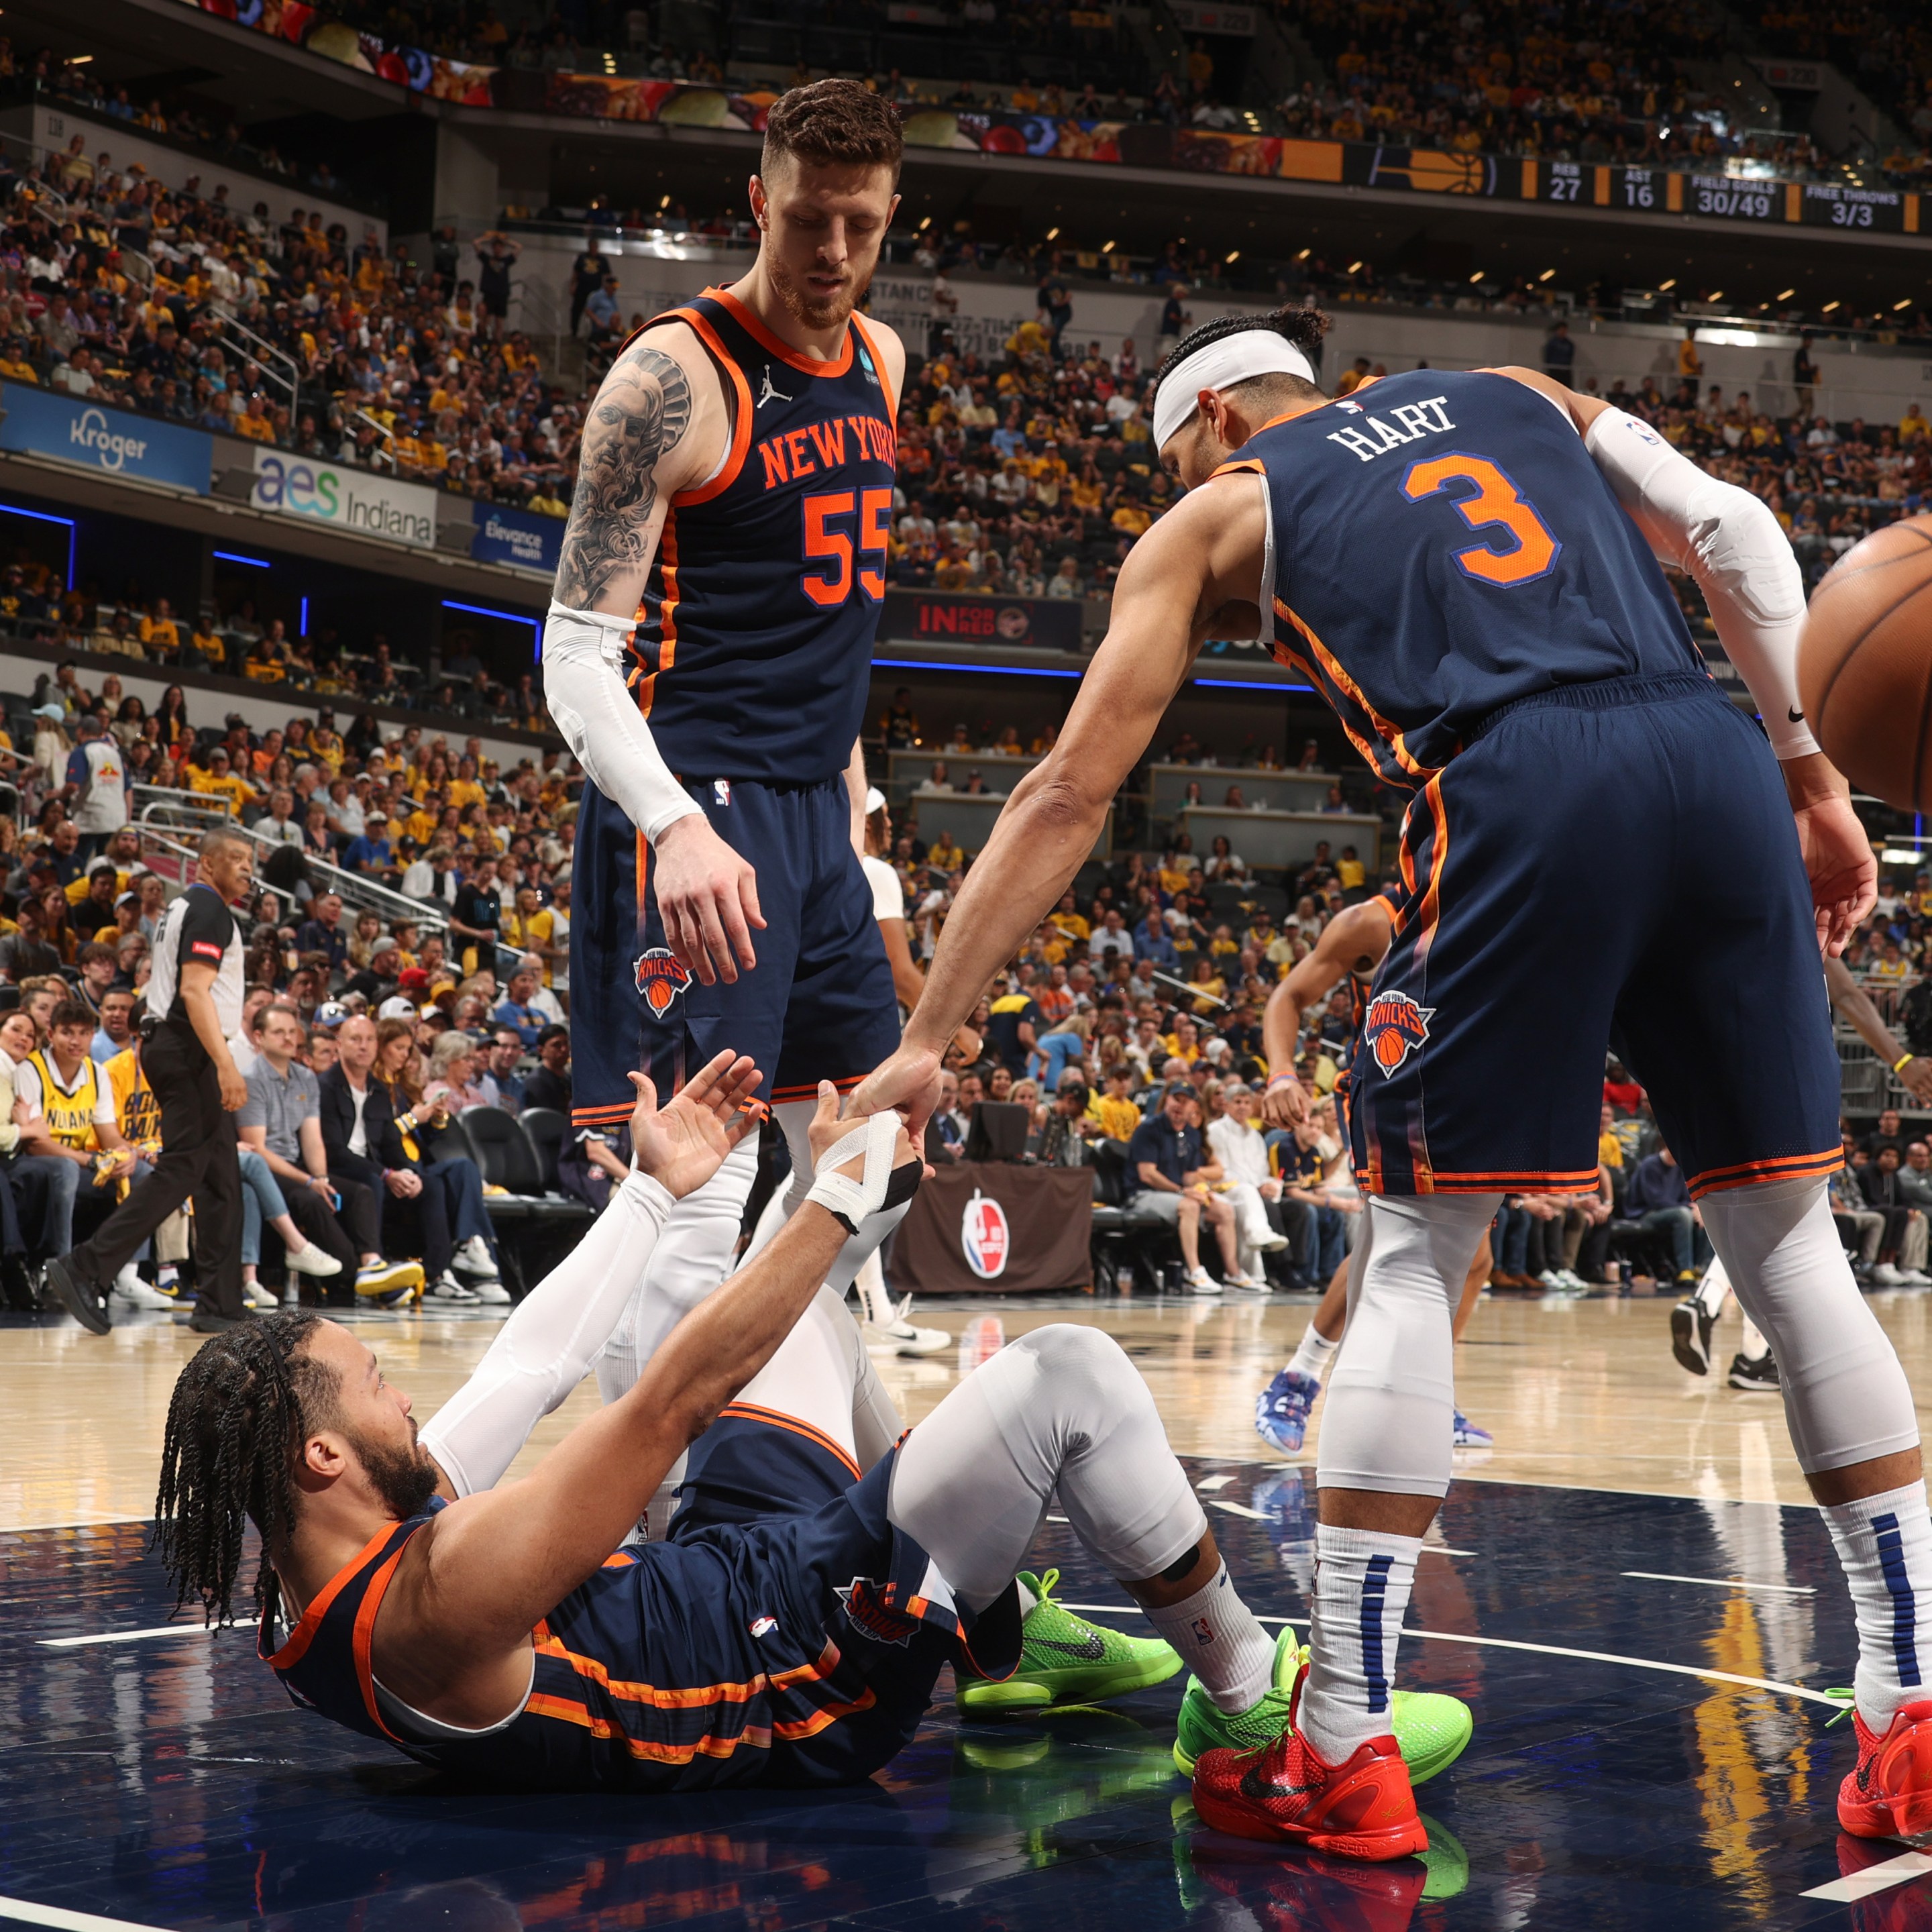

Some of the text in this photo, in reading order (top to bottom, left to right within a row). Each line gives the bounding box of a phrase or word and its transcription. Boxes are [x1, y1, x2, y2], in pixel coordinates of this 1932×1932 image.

[1550, 177, 1581, 201] 27
[1625, 169, 1651, 182] AST
[1692, 174, 1726, 191] FIELD
[1624, 183, 1654, 207] 16
[1698, 189, 1770, 218] 30/49
[1806, 186, 1899, 206] FREE THROWS
[1831, 202, 1874, 227] 3/3
[70, 408, 147, 470] Kroger
[1326, 396, 1456, 462] HART
[757, 417, 849, 492] NEW
[258, 457, 339, 519] aes
[347, 491, 432, 541] Indiana
[1397, 450, 1562, 589] 3
[485, 520, 543, 551] Elevance
[800, 484, 893, 610] 55
[511, 543, 543, 561] Health
[920, 605, 995, 633] IN FOR
[958, 620, 996, 636] RED
[637, 956, 688, 985] KNICKS
[1391, 993, 1405, 1004] YORK
[1367, 1002, 1425, 1037] KNICKS
[847, 1582, 916, 1641] KNICKS
